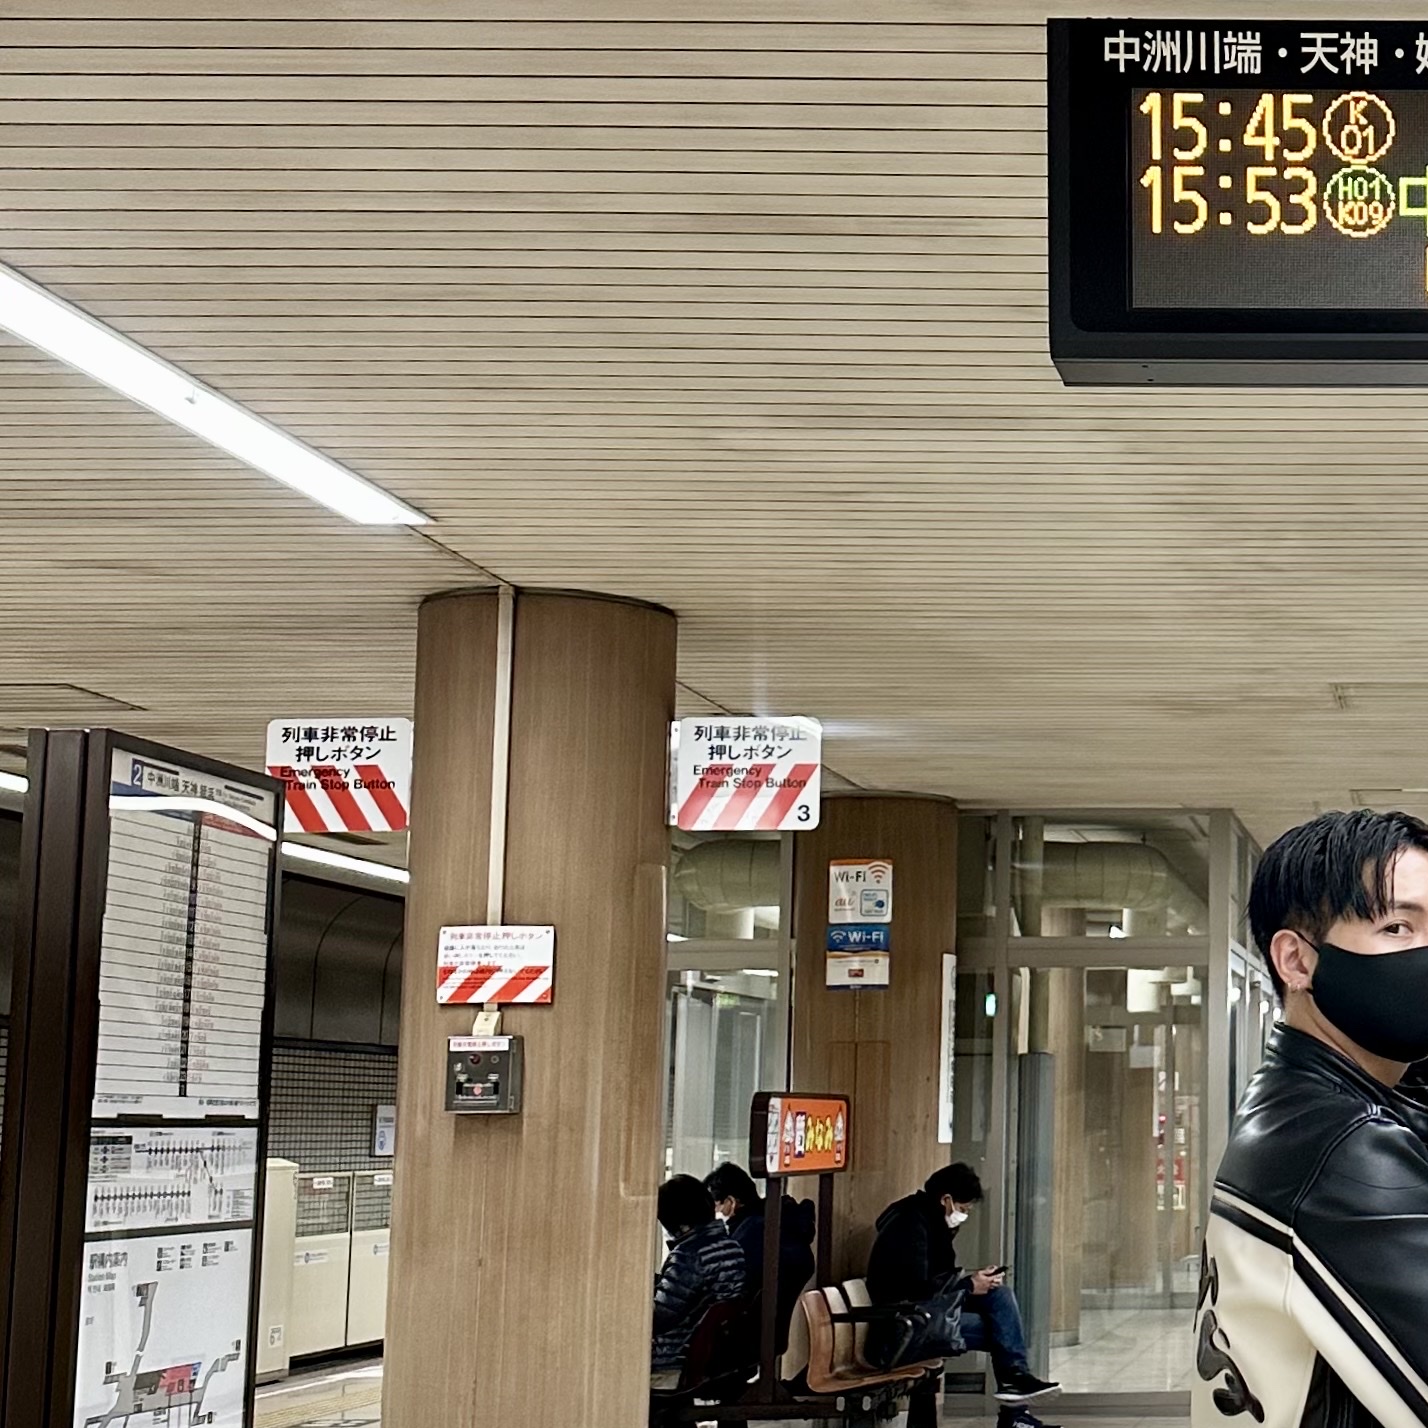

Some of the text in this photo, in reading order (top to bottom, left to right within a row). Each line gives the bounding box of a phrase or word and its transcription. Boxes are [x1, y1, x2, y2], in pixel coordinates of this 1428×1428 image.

[1349, 100, 1368, 124] K
[1139, 91, 1317, 161] 15:45
[1341, 125, 1375, 154] 01
[1139, 165, 1317, 234] 15:53
[281, 726, 397, 743] 列車非常停止
[694, 725, 807, 741] 列車非常停止
[296, 745, 381, 762] 押しボタン
[708, 744, 792, 760] 押しボタン
[280, 766, 350, 778] Emergency
[693, 765, 762, 777] Emergency
[286, 779, 395, 791] Train Stop Button
[699, 777, 806, 789] Train Stop Button
[797, 804, 810, 821] 3
[834, 871, 866, 883] Wi-Fi
[848, 931, 884, 943] Wi-Fi
